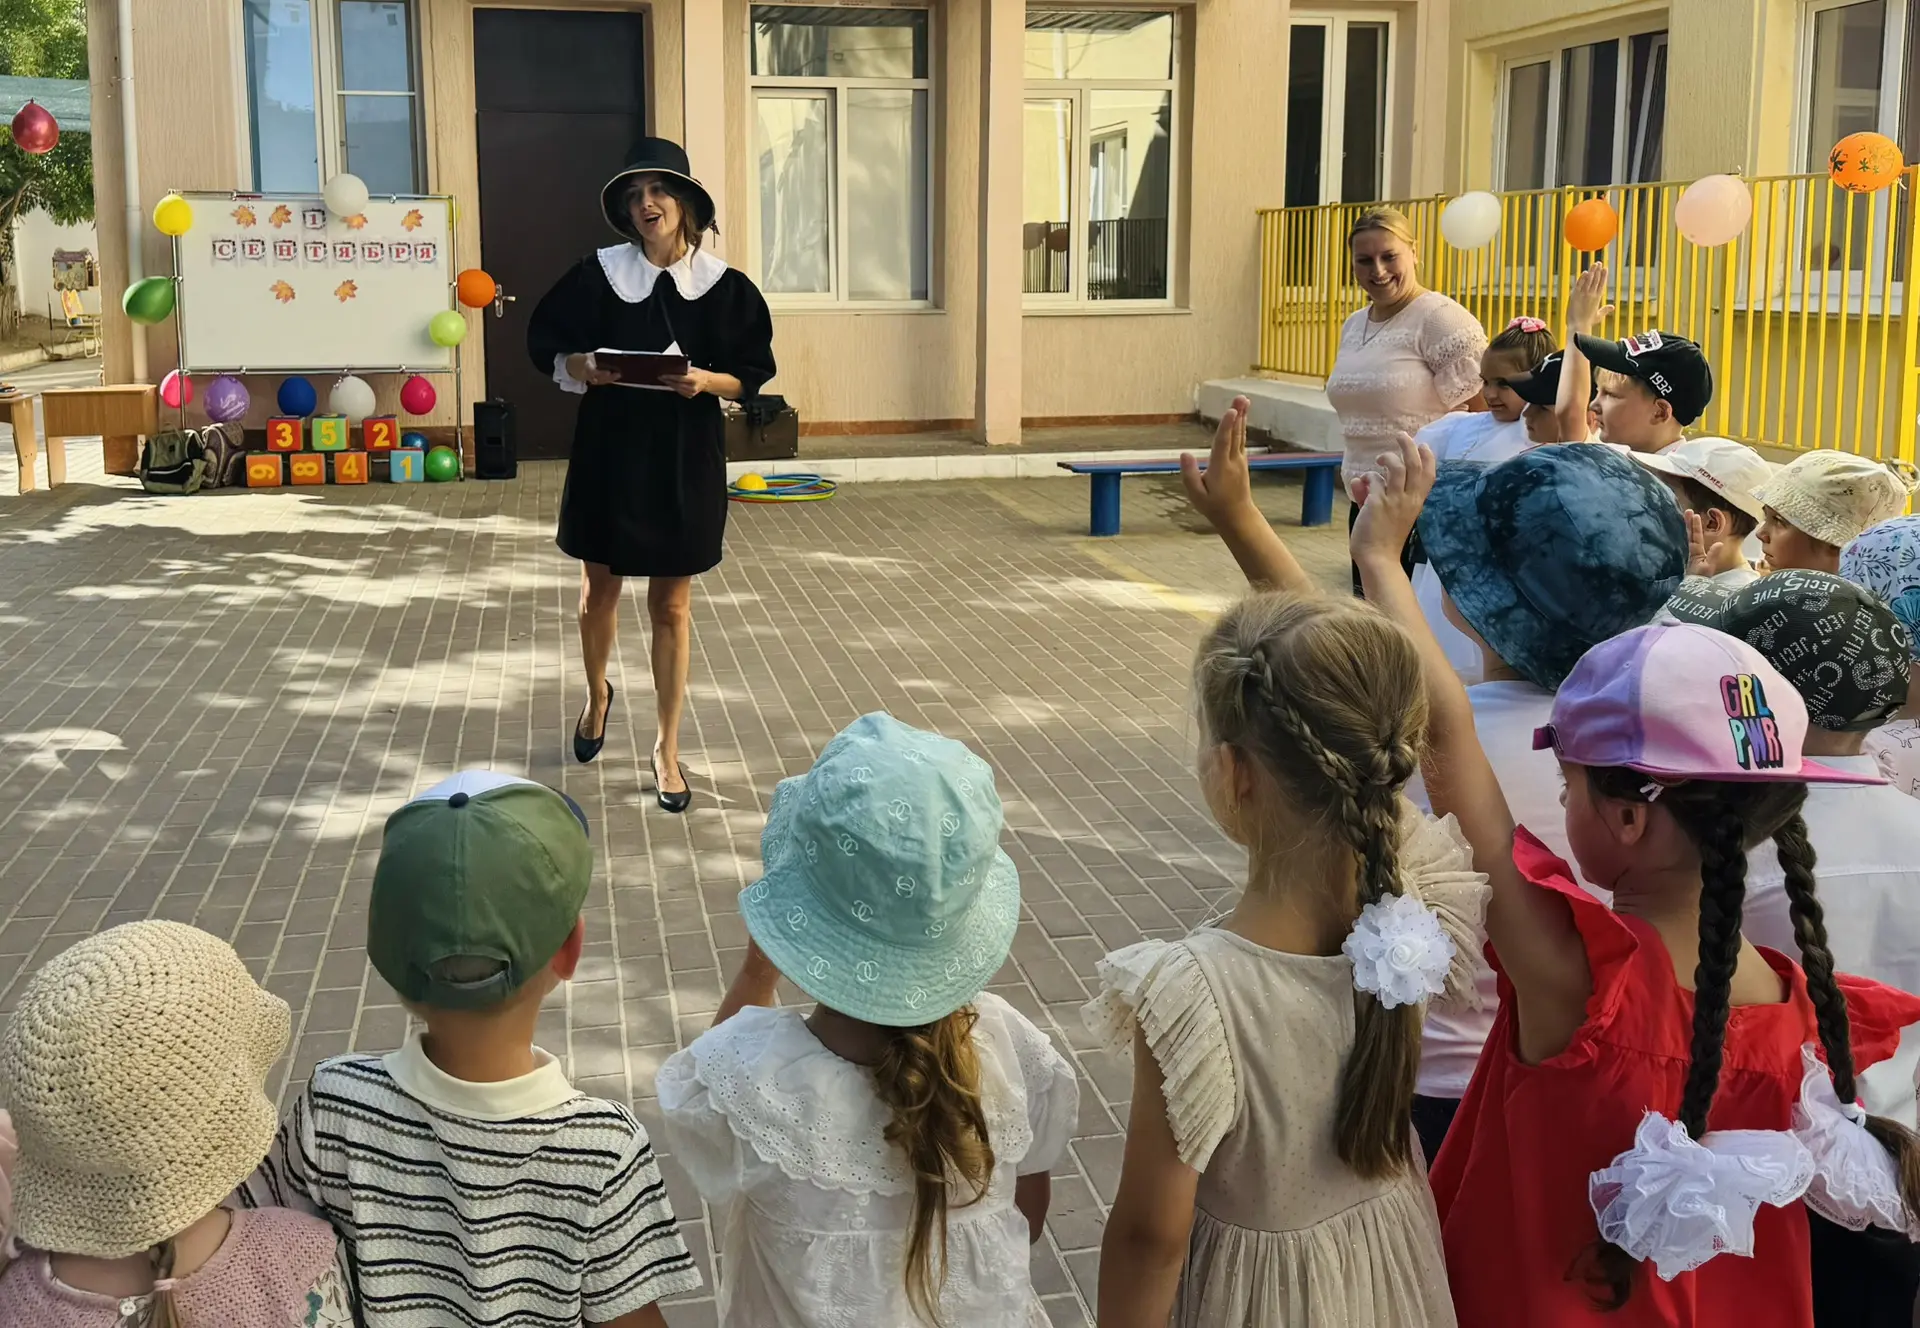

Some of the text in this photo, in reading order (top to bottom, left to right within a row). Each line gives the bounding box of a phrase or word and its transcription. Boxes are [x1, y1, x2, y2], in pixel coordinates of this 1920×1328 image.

[310, 212, 318, 226] 1
[217, 244, 433, 259] СЕНТЯБРЯ
[1649, 371, 1673, 397] 1932
[276, 422, 294, 447] 3
[320, 421, 338, 446] 5
[372, 422, 390, 447] 2
[292, 461, 319, 477] 8
[341, 455, 359, 479] 4
[399, 455, 412, 480] 1
[1751, 586, 1782, 605] FIVE
[1782, 577, 1806, 592] 5
[1803, 577, 1841, 593] JECI
[1665, 594, 1720, 620] JECI FIVE
[1813, 611, 1847, 636] JECI
[1778, 636, 1810, 666] JECI
[1719, 673, 1773, 719] GRL
[1729, 717, 1784, 770] PWR
